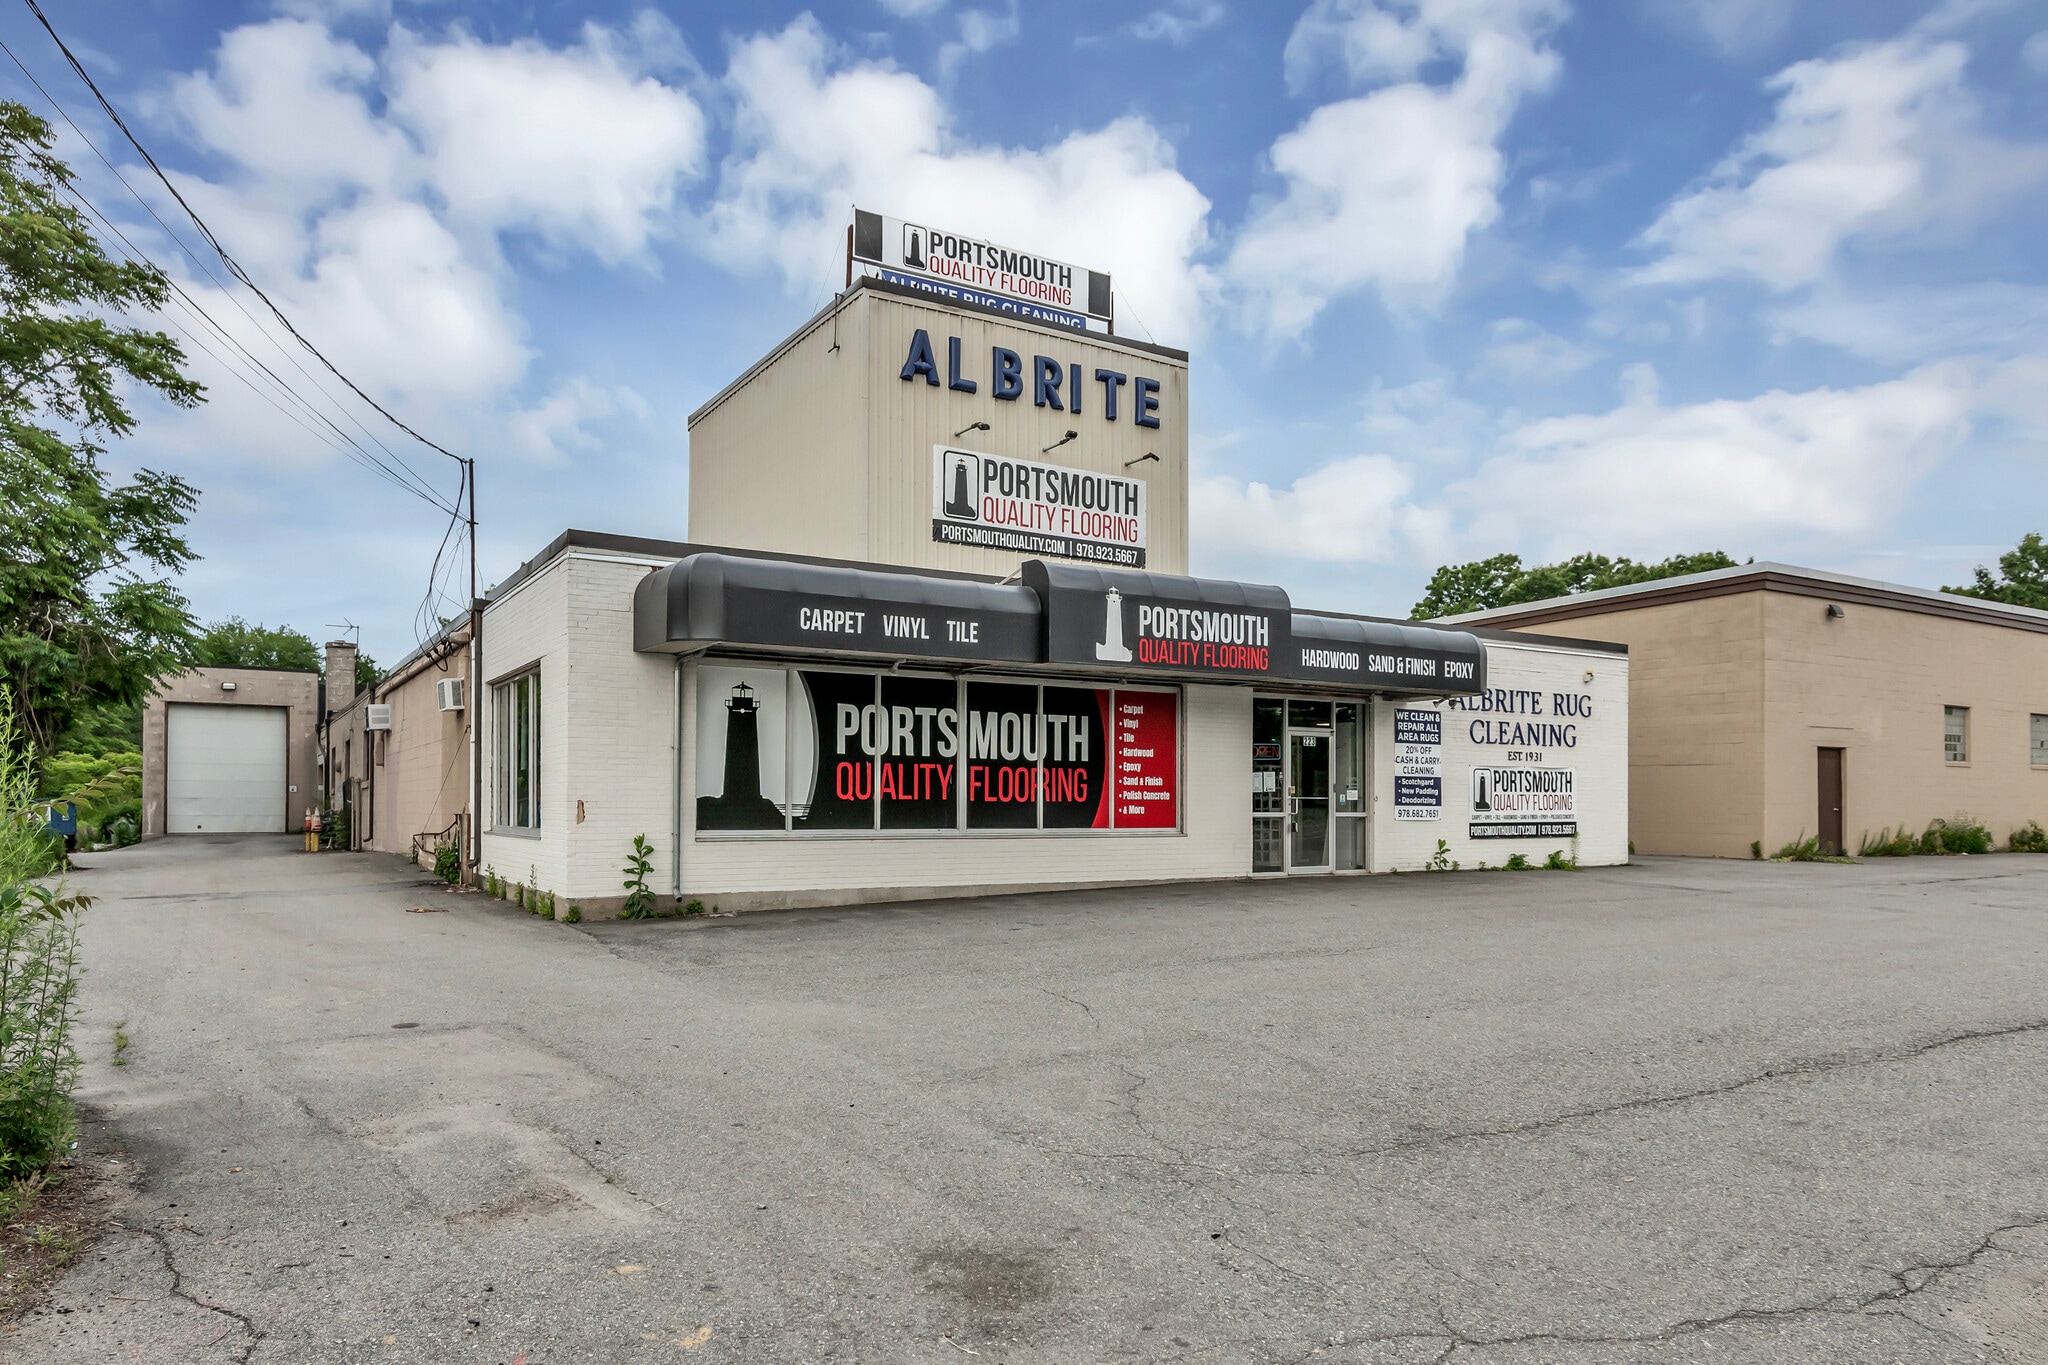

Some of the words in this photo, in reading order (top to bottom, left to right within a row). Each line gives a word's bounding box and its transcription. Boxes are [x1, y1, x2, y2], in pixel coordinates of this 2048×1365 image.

[930, 231, 1072, 289] PORTSMOUTH
[929, 255, 996, 287] QUALITY
[1000, 274, 1071, 306] FLOORING
[900, 329, 1160, 429] ALBRITE
[983, 458, 1138, 516] PORTSMOUTH
[983, 496, 1056, 531] QUALITY
[1061, 508, 1138, 543] FLOORING
[941, 524, 1065, 555] PORTSMOUTHQUALITY.COM
[1076, 543, 1138, 564] 978.923.5667
[800, 607, 865, 634] CARPET
[882, 614, 930, 640] VINYL
[946, 620, 979, 643] TILE
[1139, 604, 1269, 647] PORTSMOUTH
[1139, 638, 1200, 666] QUALITY
[1203, 643, 1269, 671] FLOORING
[1302, 648, 1360, 671] HARDWOOD
[1368, 654, 1394, 673] SAND
[1397, 657, 1403, 674] &
[1405, 657, 1436, 677] FINISH
[1444, 661, 1474, 679] EPOXY
[1123, 704, 1144, 715] Carpet
[1553, 693, 1592, 718] RUG
[1395, 711, 1409, 720] WE
[1410, 712, 1434, 722] CLEAN
[1435, 714, 1440, 722] &
[1123, 719, 1139, 729] Vinyl
[1397, 722, 1425, 731] REPAIR
[1426, 723, 1439, 732] ALL
[1123, 733, 1135, 742] Tile
[1397, 732, 1419, 741] AREA
[1420, 733, 1439, 742] RUGS
[1469, 719, 1577, 748] CLEANING
[1123, 747, 1154, 758] Hardwood
[1406, 745, 1419, 754] 20%
[1420, 746, 1432, 755] OFF
[1395, 755, 1414, 764] CASH
[1414, 756, 1419, 764] &
[1420, 757, 1440, 765] CARRY
[1525, 752, 1543, 762] 1931
[1123, 762, 1141, 772] Epoxy
[1402, 766, 1435, 775] CLEANING
[836, 761, 954, 801] QUALITY
[969, 765, 1088, 803] FLOORING
[1123, 776, 1138, 786] Sand
[1139, 777, 1144, 785] &
[1145, 776, 1163, 786] Finish
[1401, 778, 1434, 786] Scotchgard
[1494, 770, 1572, 793] PORTSMOUTH
[1123, 790, 1142, 800] Polish
[1143, 791, 1170, 801] Concrete
[1415, 788, 1439, 796] Padding
[1401, 797, 1436, 805] Deodorizing
[1494, 794, 1531, 811] QUALITY
[1533, 794, 1573, 811] FLOORING
[1123, 805, 1128, 814] &
[1128, 805, 1145, 814] More
[1397, 809, 1439, 818] 978.682.7651
